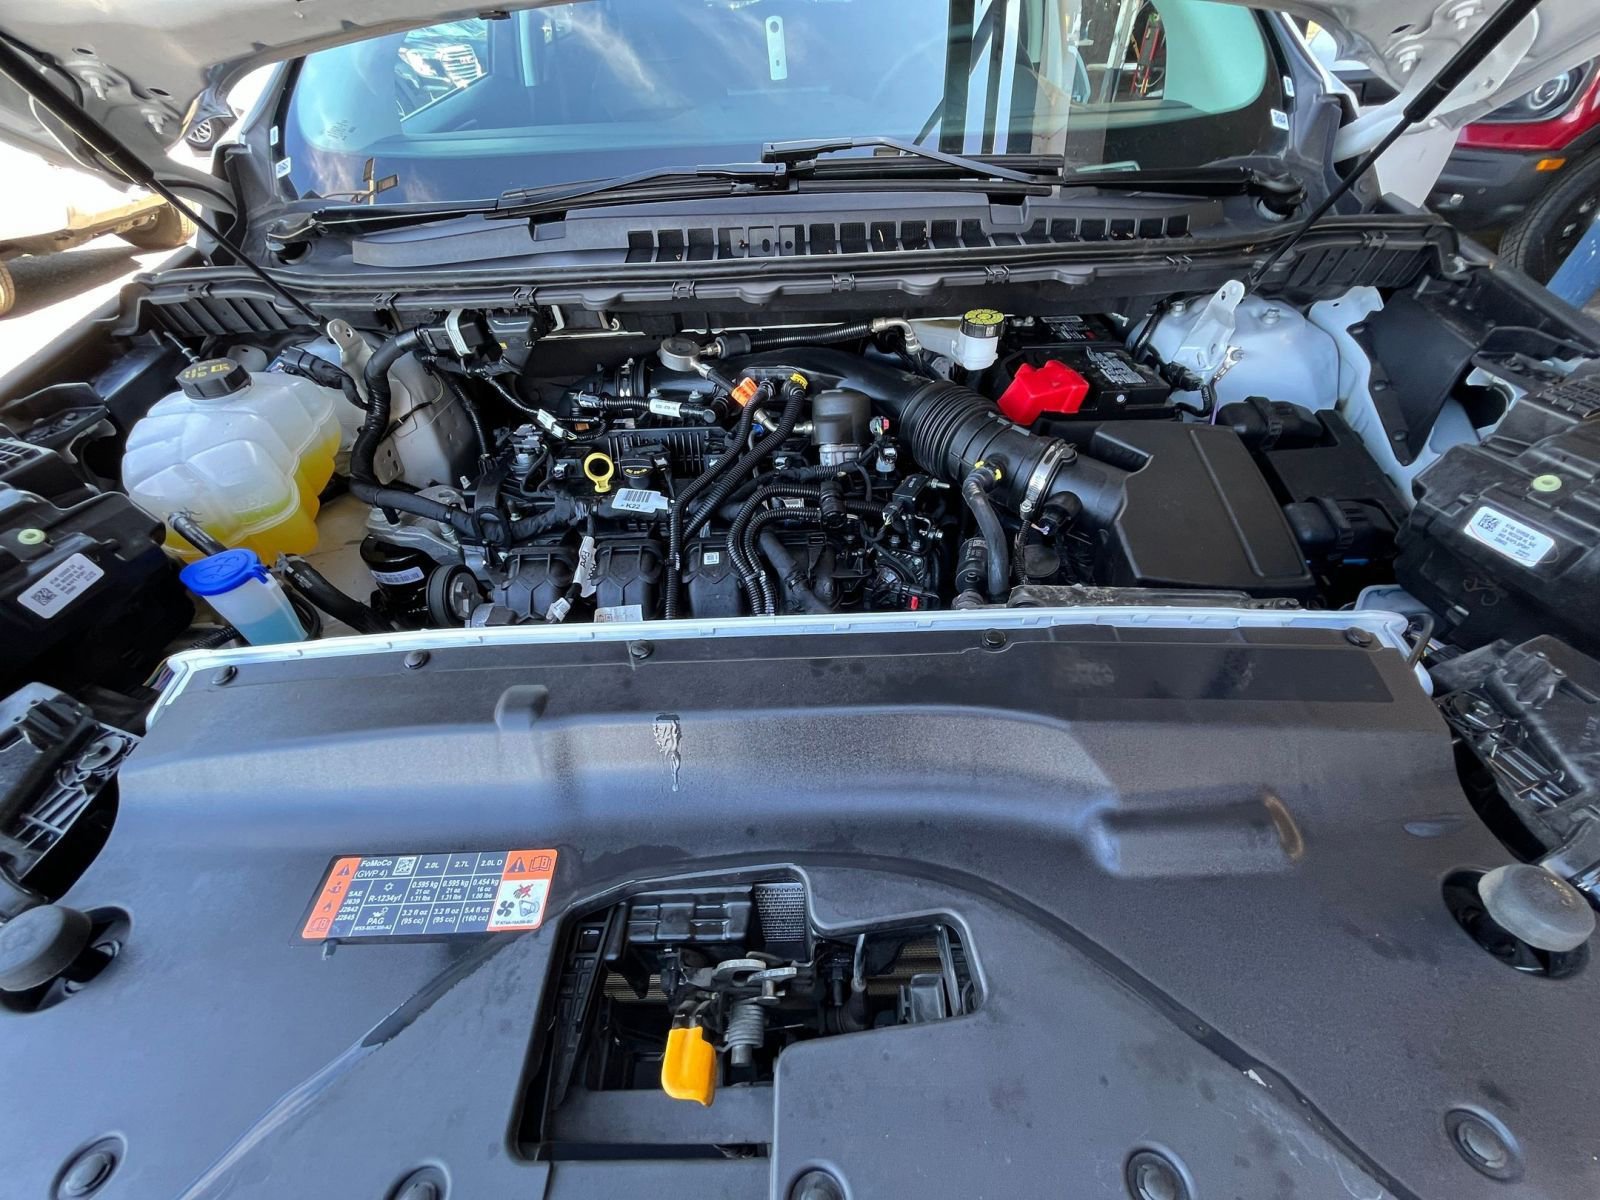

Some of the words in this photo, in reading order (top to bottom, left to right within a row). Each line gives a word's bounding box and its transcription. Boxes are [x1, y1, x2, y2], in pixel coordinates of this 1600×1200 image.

[580, 550, 590, 569] Ford
[354, 870, 378, 878] (GWP
[379, 870, 387, 878] 4)
[430, 880, 438, 889] kg
[491, 878, 499, 886] kg
[368, 894, 402, 902] R-1234yf
